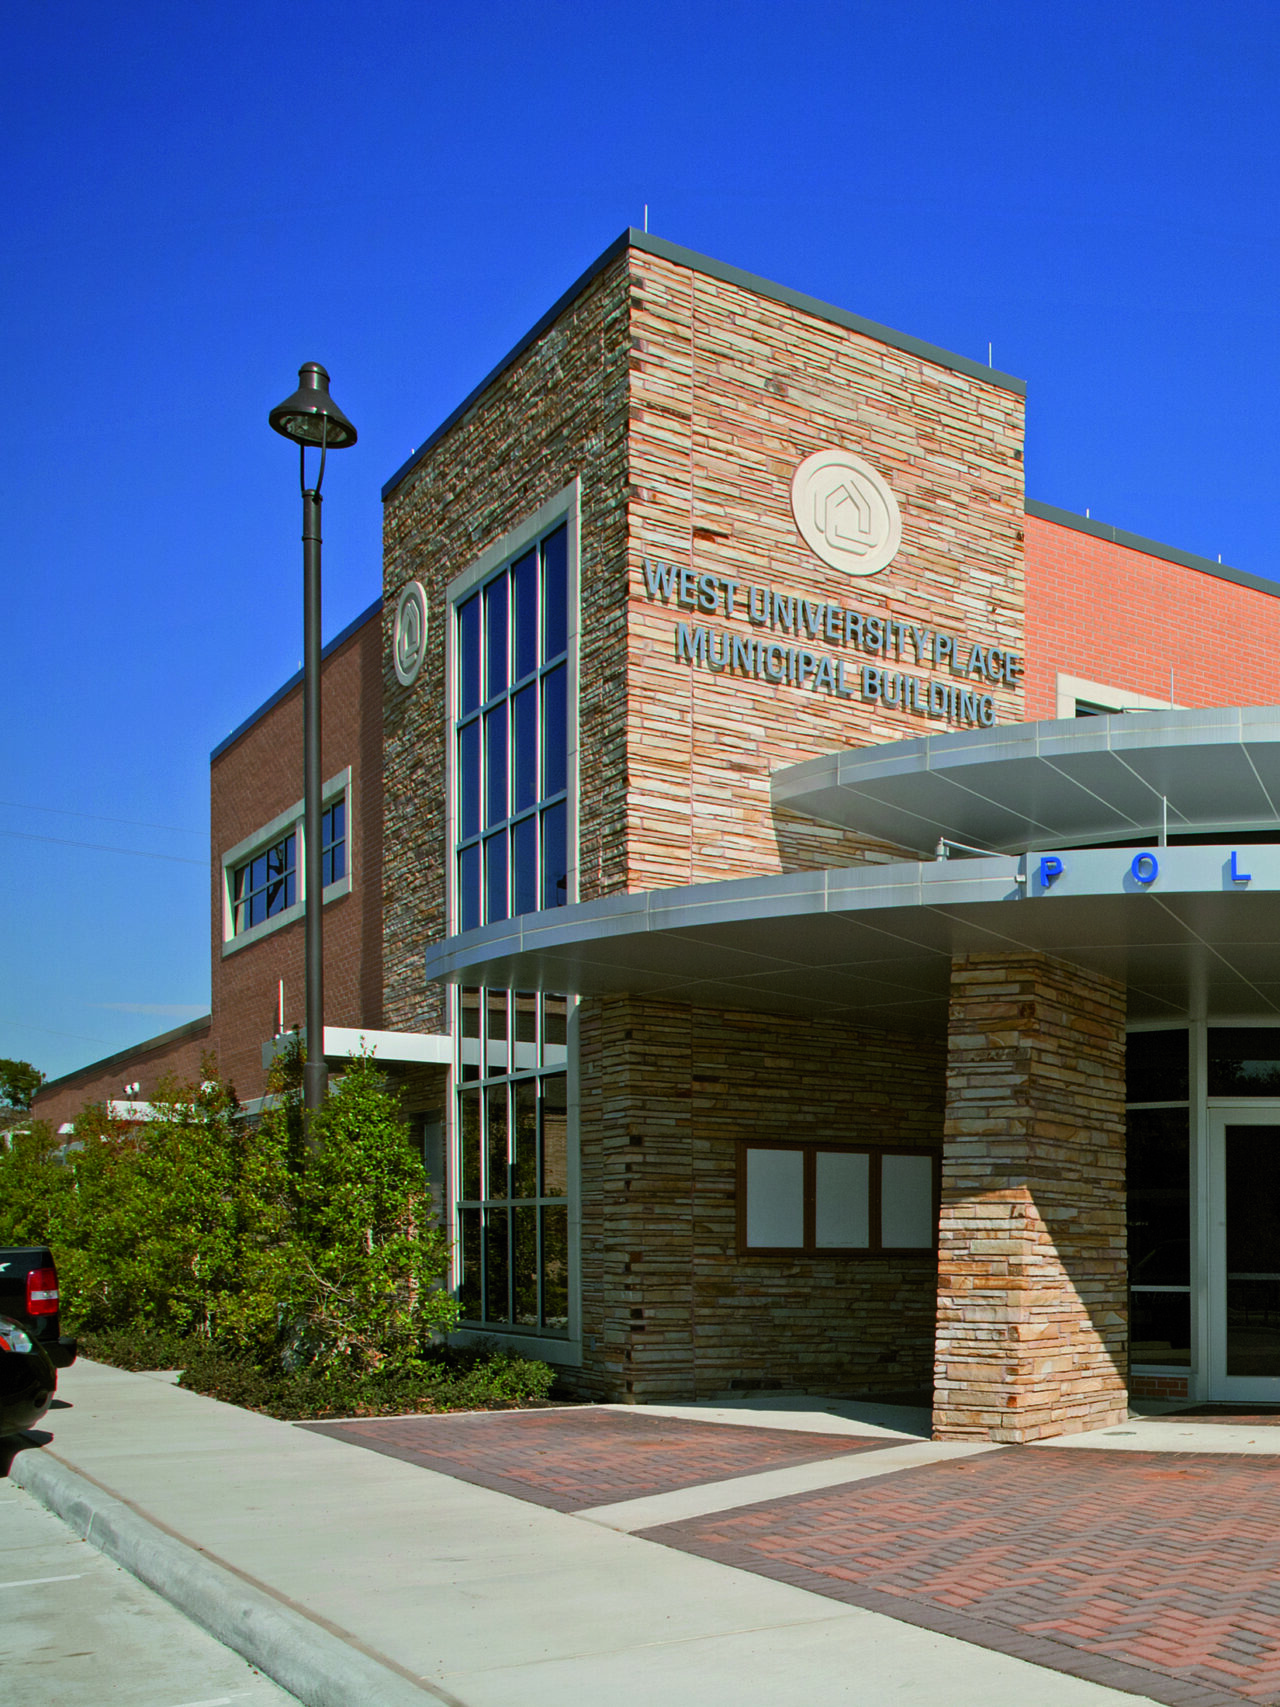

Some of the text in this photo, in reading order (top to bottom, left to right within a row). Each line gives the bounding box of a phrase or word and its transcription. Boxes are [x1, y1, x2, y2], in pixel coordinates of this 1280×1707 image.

[644, 559, 1022, 686] WEST UNIVERSITY PLACE
[675, 622, 997, 728] MUNICIPAL BUILDING
